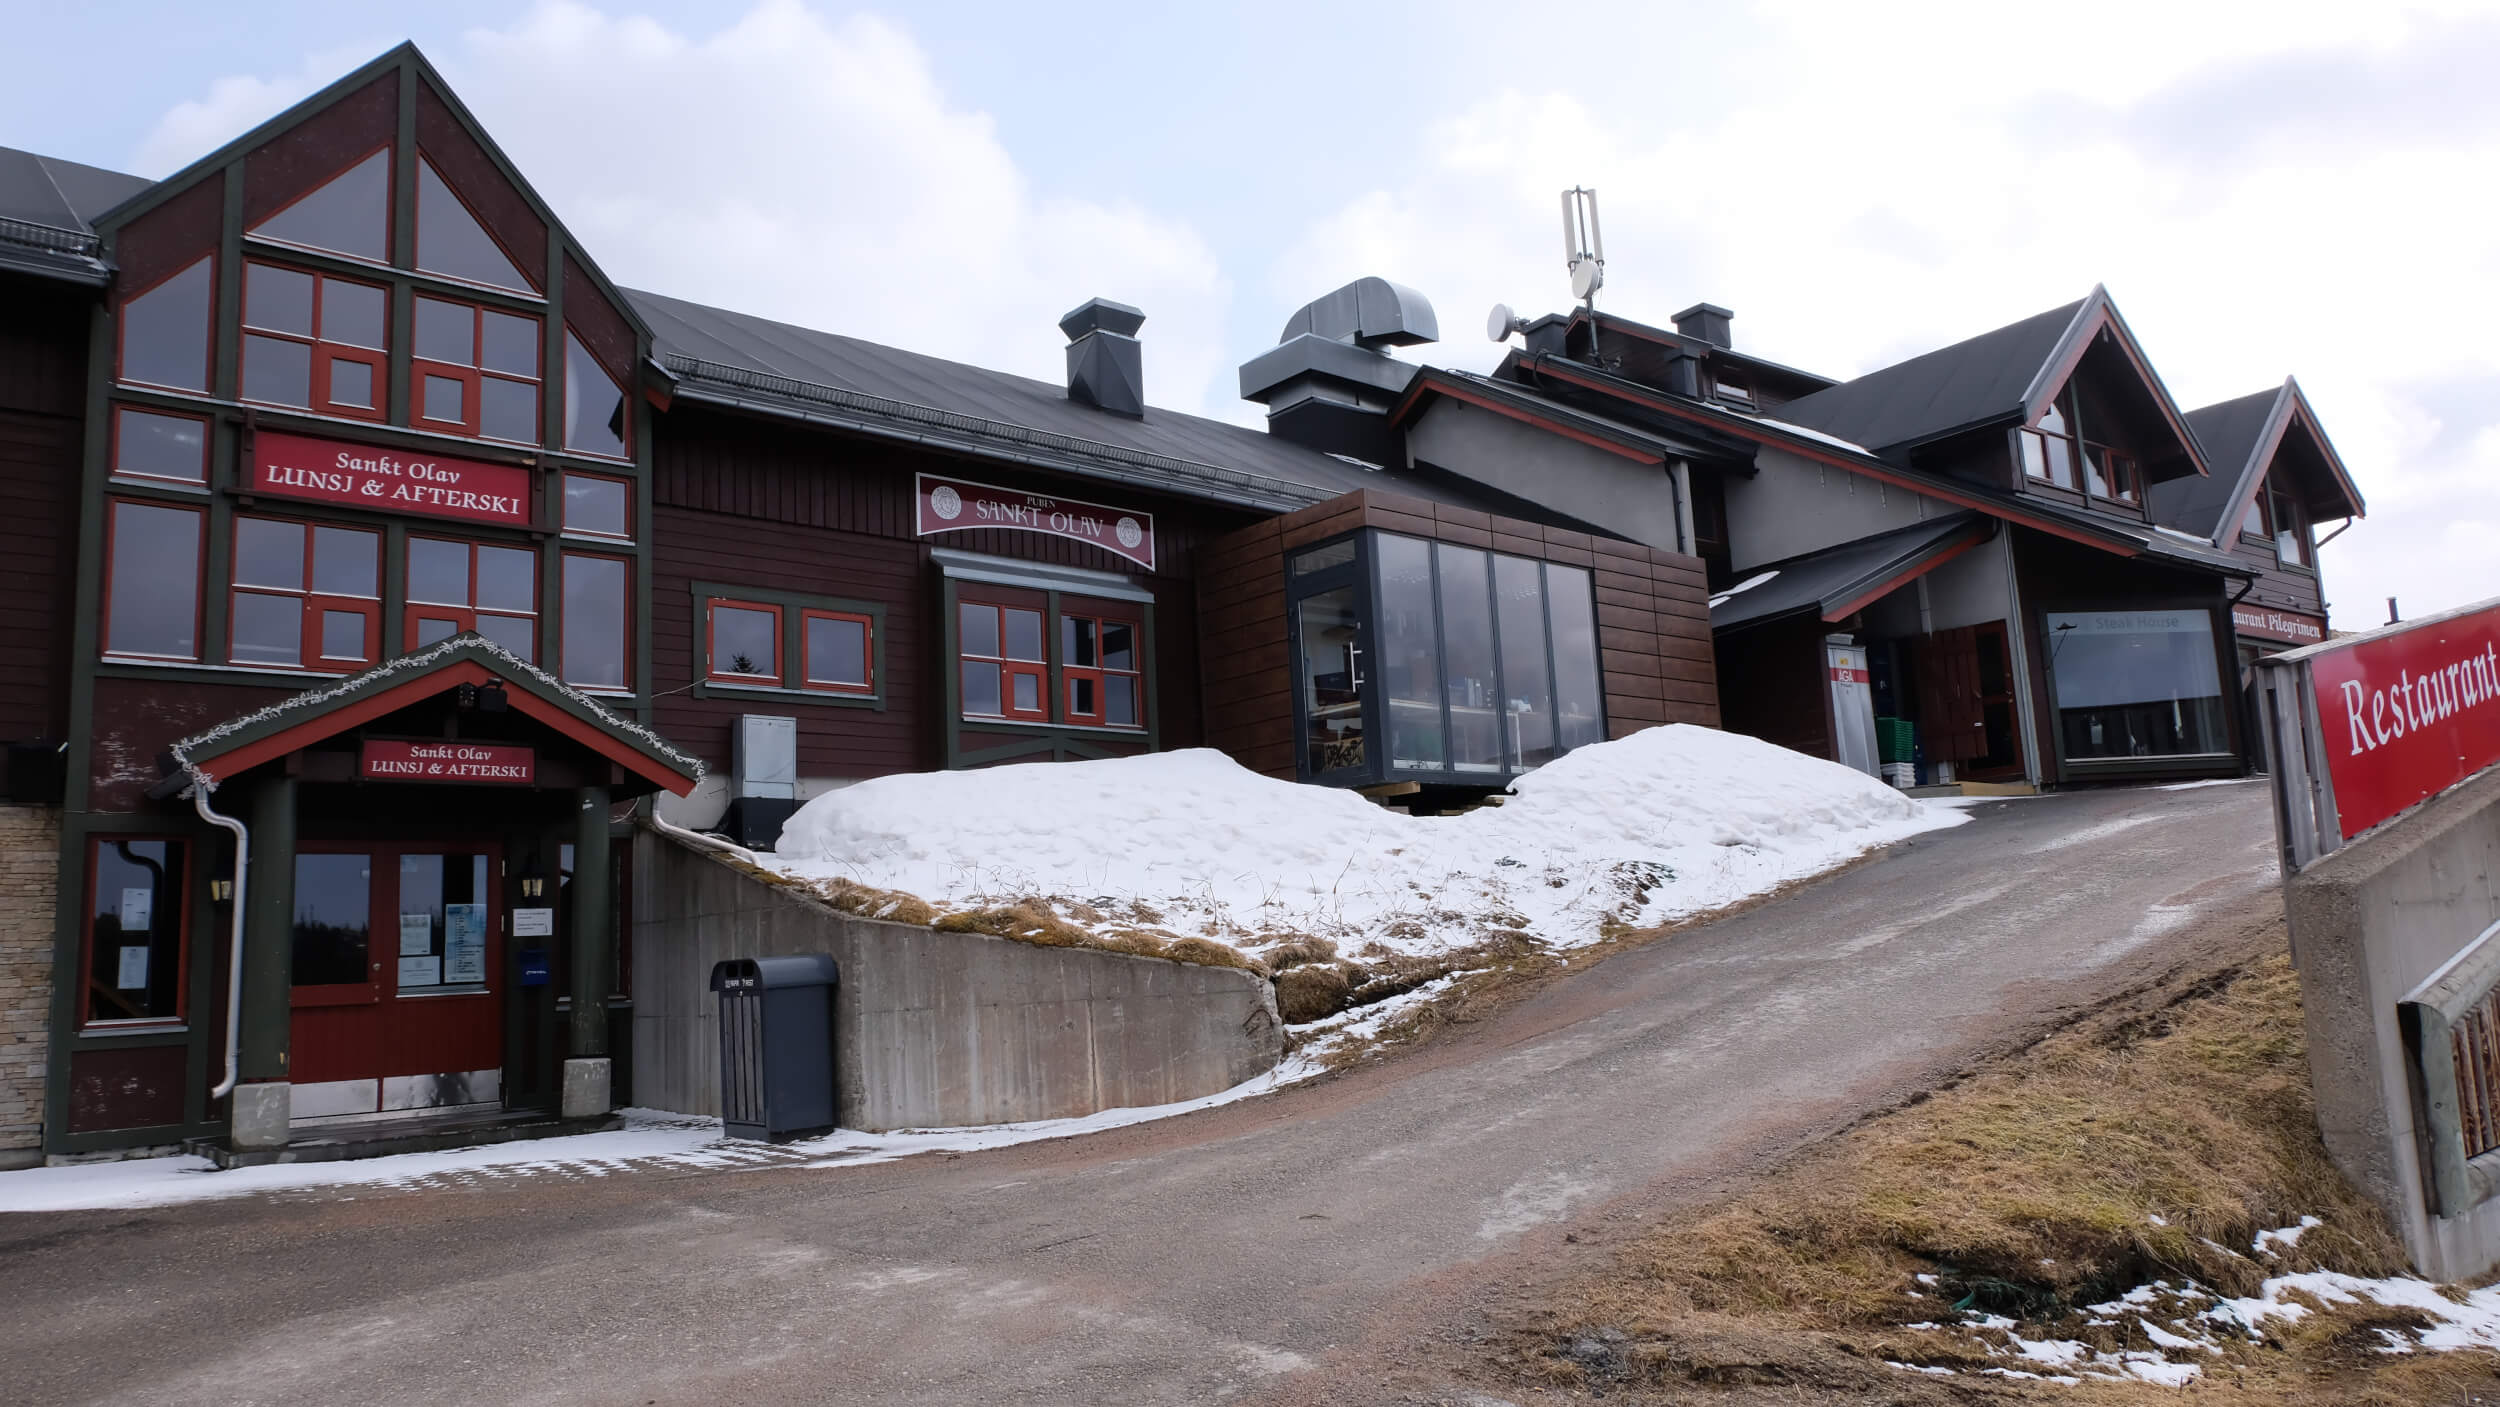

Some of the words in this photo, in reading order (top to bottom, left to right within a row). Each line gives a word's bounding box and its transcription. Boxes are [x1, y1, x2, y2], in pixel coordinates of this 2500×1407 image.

[335, 452, 402, 477] Sankt
[408, 462, 461, 484] Olav
[266, 464, 353, 493] LUNSJ
[360, 479, 384, 497] &
[390, 483, 521, 515] AFTERSKI
[1027, 496, 1056, 509] PUBEN
[976, 499, 1042, 527] SANKT
[1050, 512, 1104, 537] OLAV
[2095, 616, 2132, 629] Steak
[2137, 615, 2179, 628] House
[2232, 611, 2267, 629] aurant
[2267, 612, 2321, 639] Pilegrimen
[2340, 640, 2500, 756] Restaurant
[410, 745, 454, 759] Sankt
[457, 747, 492, 760] Olav
[371, 760, 424, 774] LUNSJ
[427, 762, 443, 774] &
[447, 763, 528, 778] AFTERSKI
